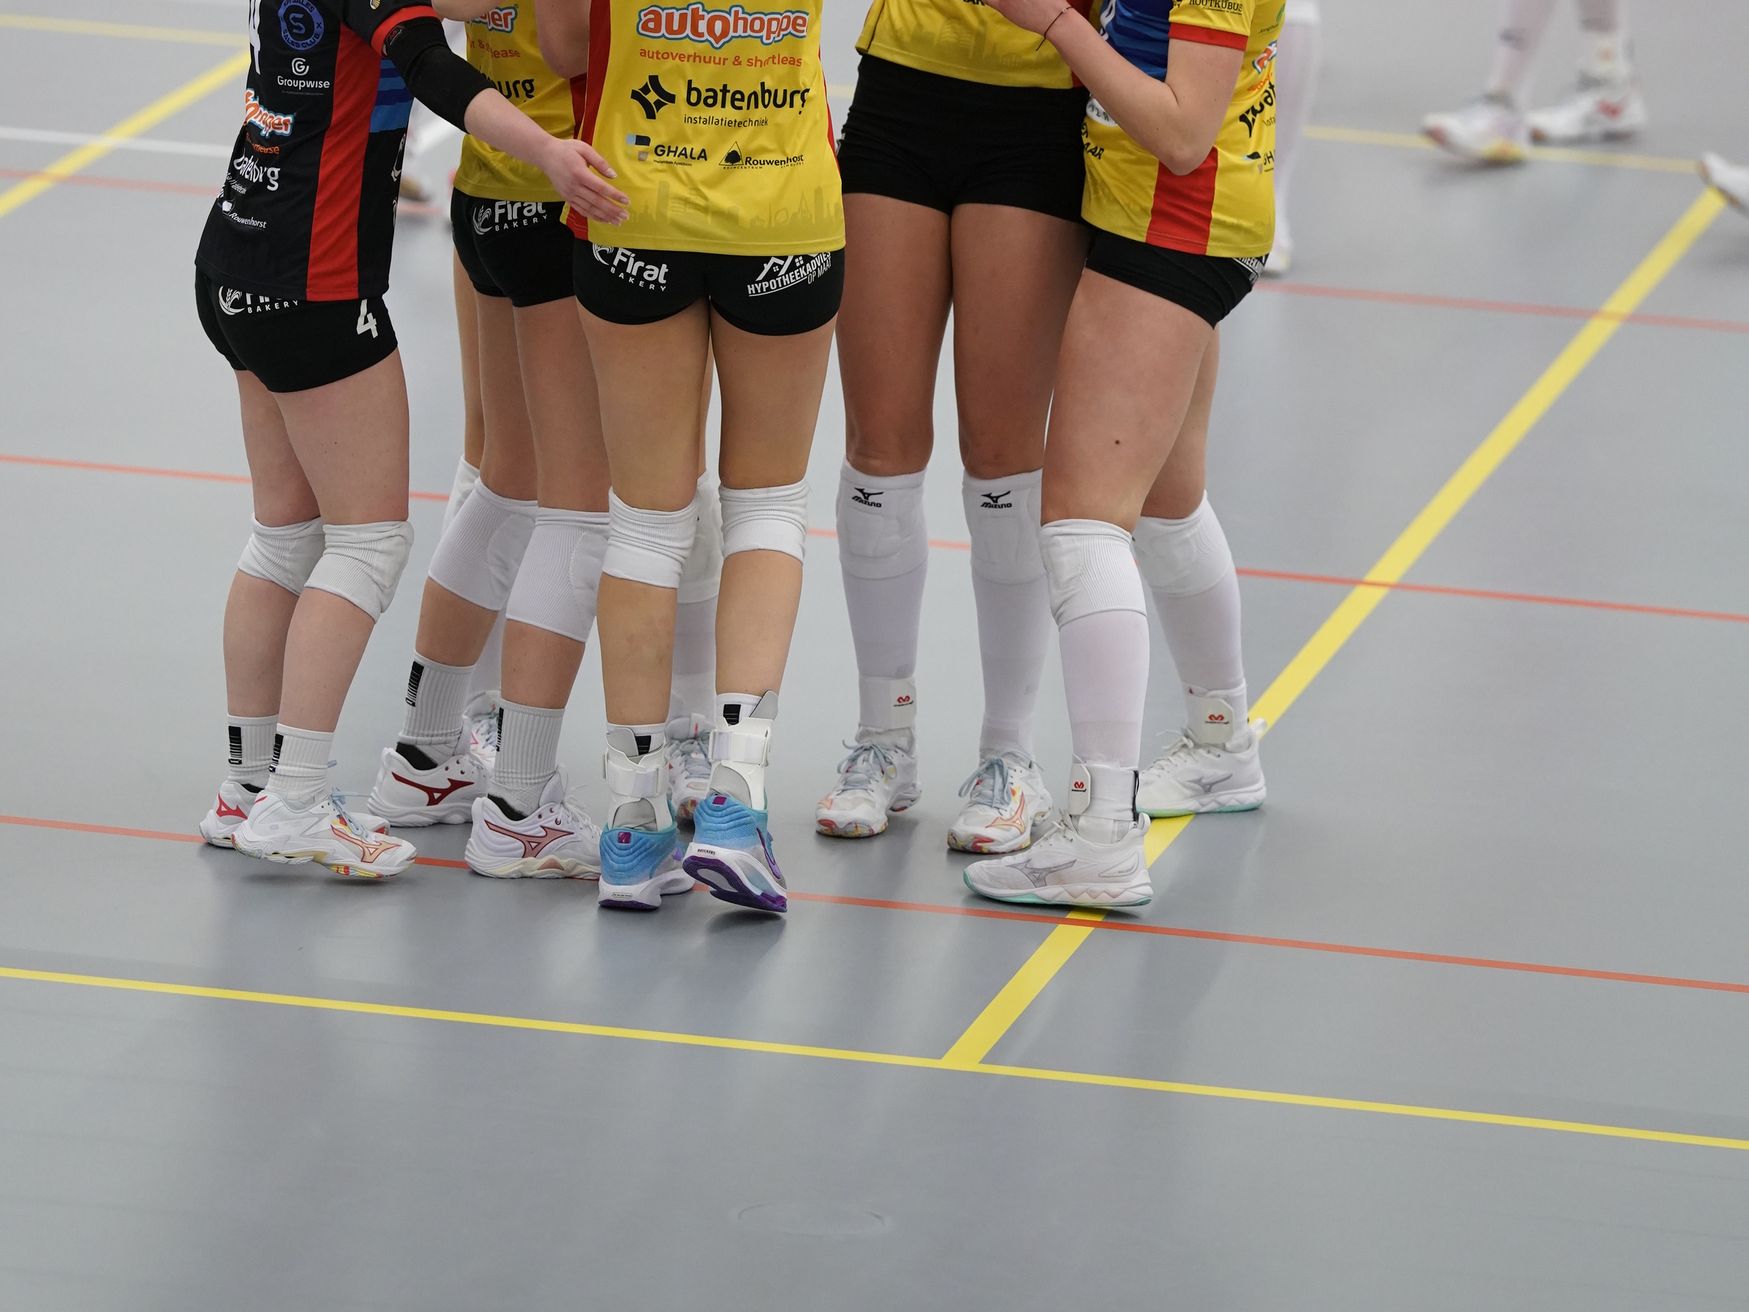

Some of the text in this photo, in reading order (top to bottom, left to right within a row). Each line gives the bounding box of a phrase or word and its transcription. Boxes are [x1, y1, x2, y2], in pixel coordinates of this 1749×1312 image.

[639, 48, 729, 67] autoverhuur
[732, 55, 743, 67] &
[277, 75, 330, 90] Groupwise
[683, 114, 769, 129] installatietechniek
[654, 144, 709, 162] GHALA
[494, 214, 548, 232] BAKERY
[612, 246, 670, 285] Firat
[610, 266, 668, 292] BAKERY
[356, 299, 379, 338] 4
